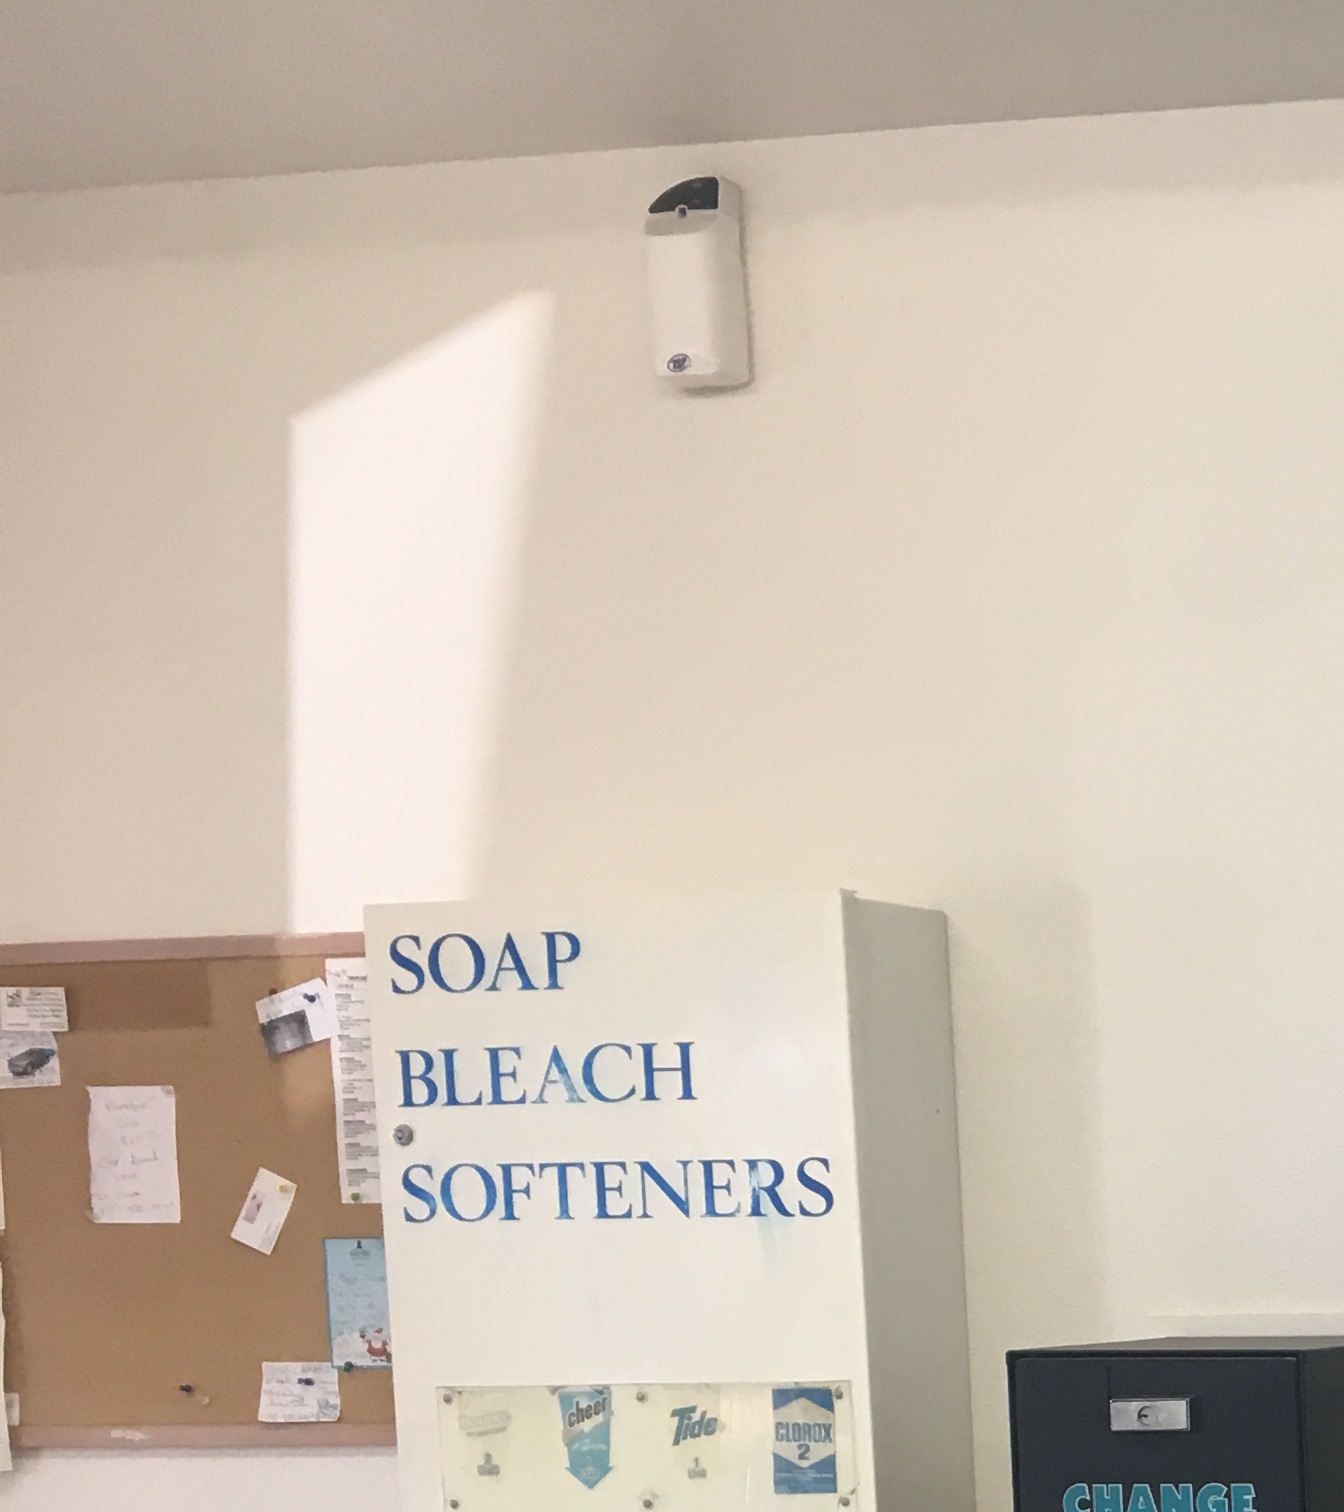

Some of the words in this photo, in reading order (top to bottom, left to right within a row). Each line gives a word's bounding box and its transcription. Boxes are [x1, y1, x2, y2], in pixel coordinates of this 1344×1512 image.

[389, 930, 582, 996] SOAP
[396, 1041, 698, 1108] BLEACH
[402, 1156, 835, 1223] SOFTENERS
[671, 1405, 718, 1446] Tide
[775, 1422, 833, 1444] CLOROX
[797, 1443, 810, 1461] 2
